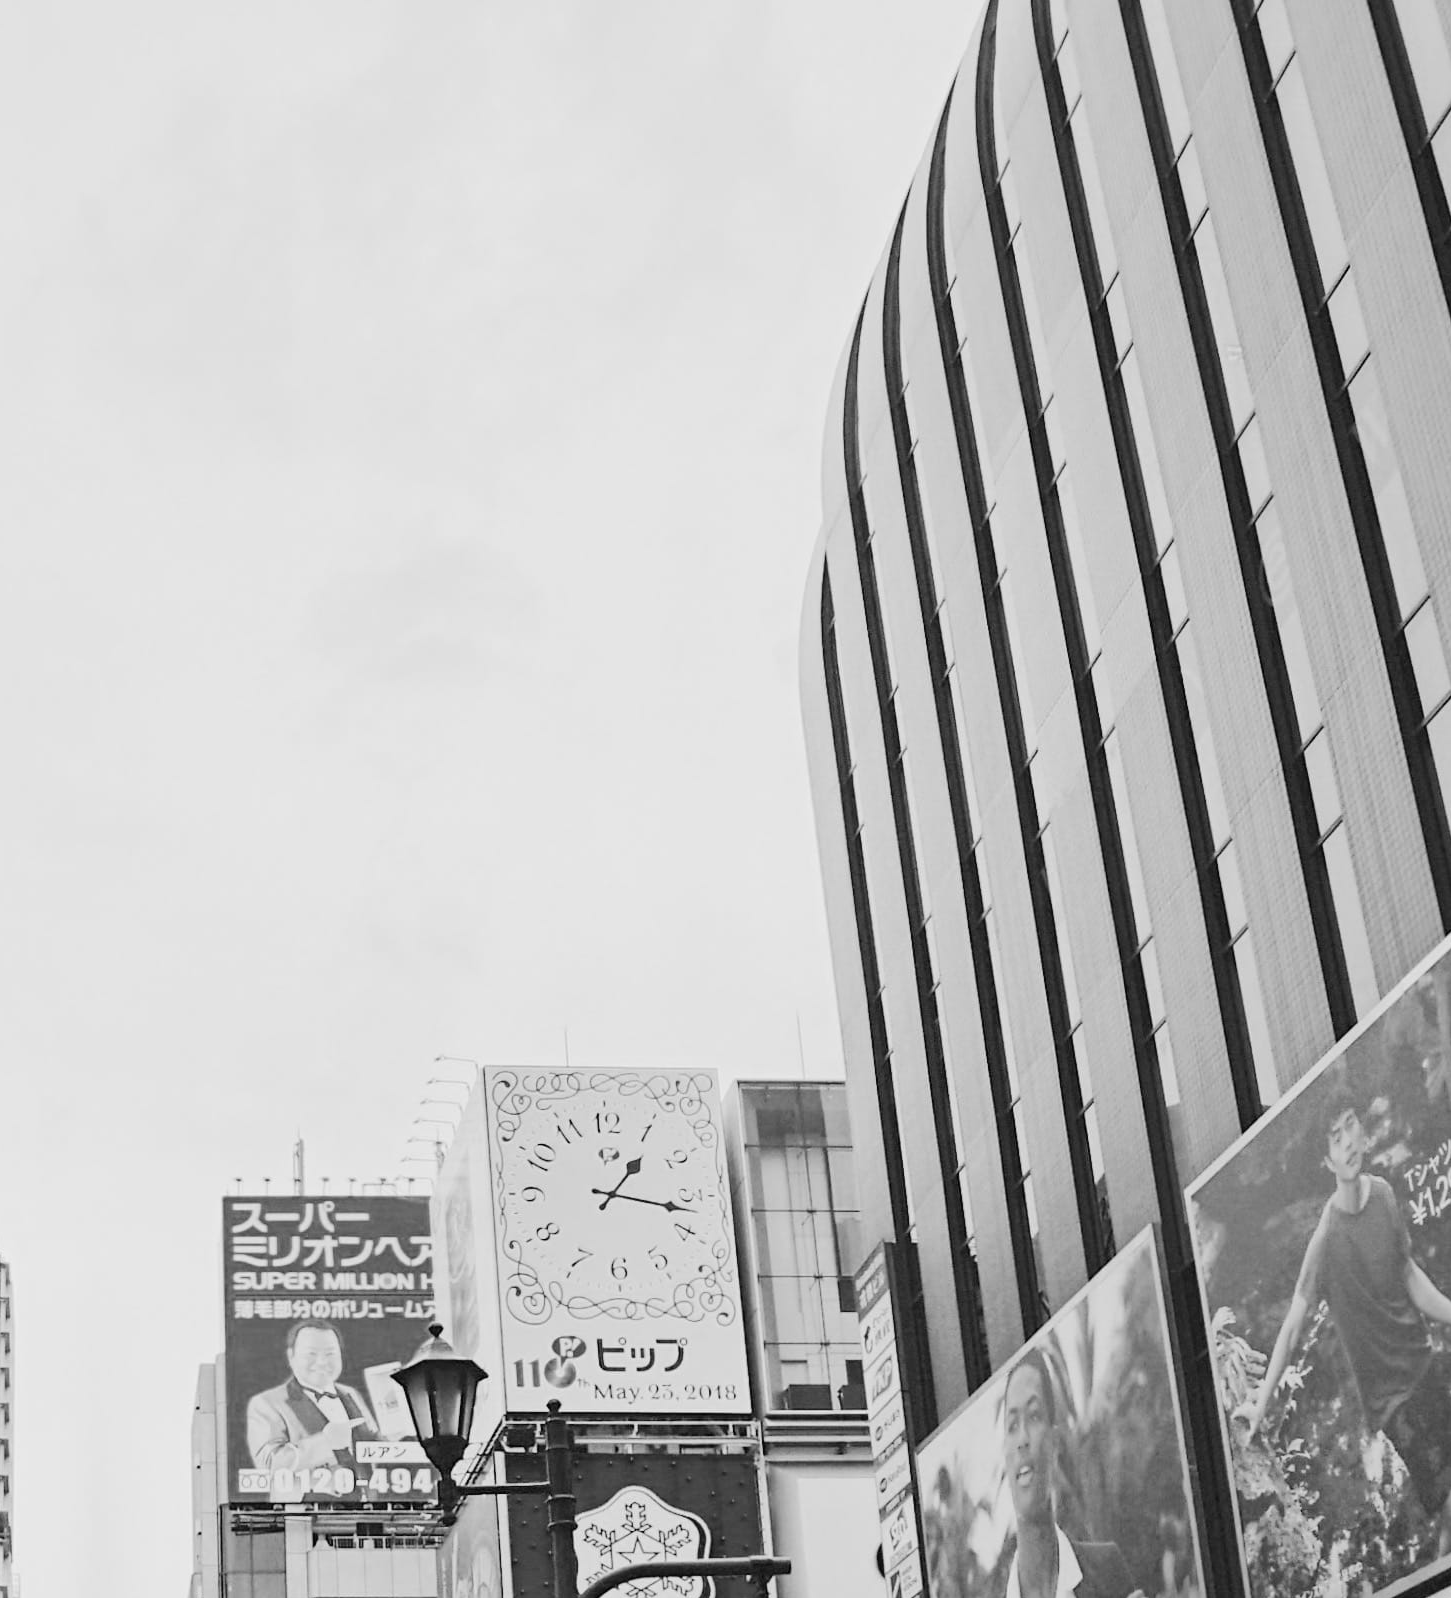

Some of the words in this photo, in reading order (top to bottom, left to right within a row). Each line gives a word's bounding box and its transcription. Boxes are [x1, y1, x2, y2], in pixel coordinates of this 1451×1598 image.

[556, 1118, 583, 1144] 11
[594, 1112, 621, 1135] 12
[641, 1124, 653, 1142] 1
[526, 1142, 557, 1172] 10
[663, 1149, 688, 1169] 2
[521, 1185, 546, 1202] 9
[677, 1187, 703, 1203] 3
[231, 1200, 370, 1234] スーパー
[535, 1221, 560, 1242] 8
[673, 1222, 697, 1242] 4
[571, 1248, 594, 1268] 7
[647, 1245, 669, 1271] 5
[610, 1256, 629, 1281] 6
[232, 1271, 317, 1291] SUPER
[323, 1272, 415, 1291] MILLION
[596, 1337, 688, 1372] ピップ
[686, 1384, 738, 1401] 2018
